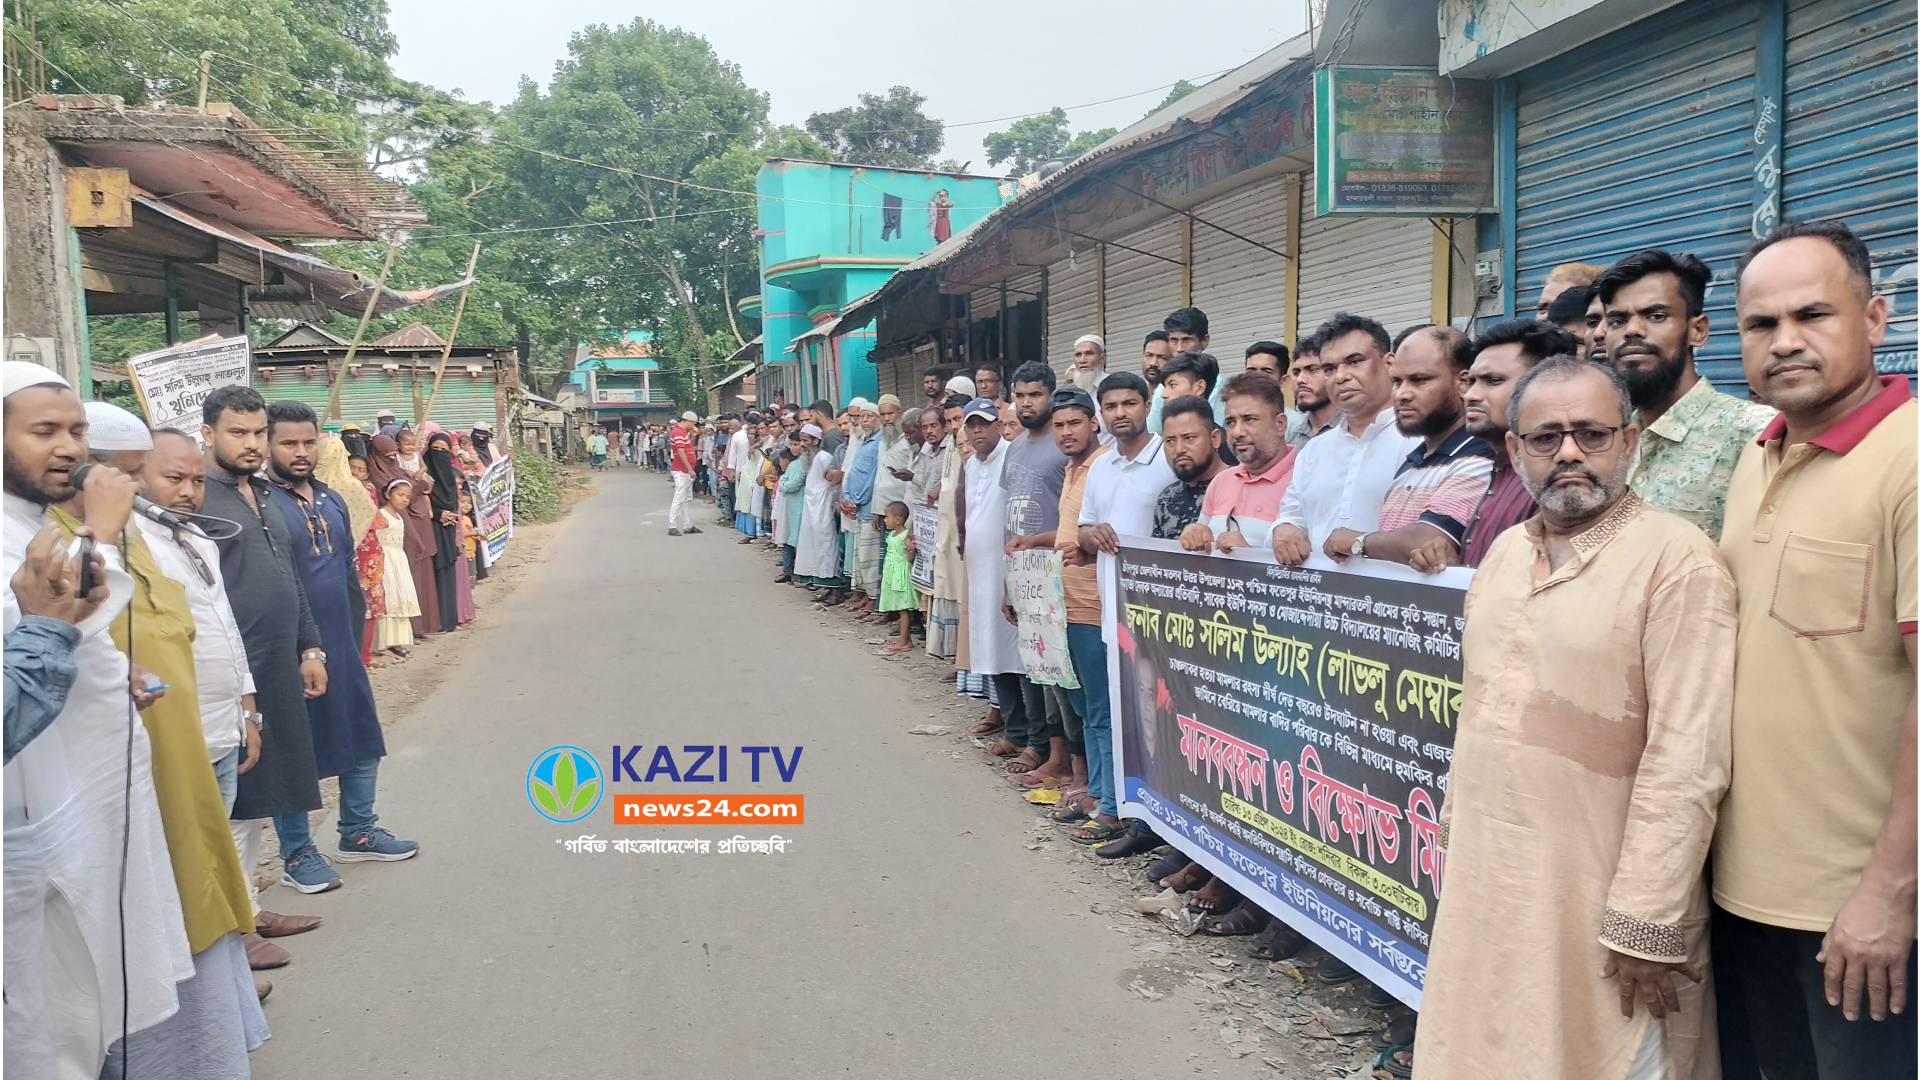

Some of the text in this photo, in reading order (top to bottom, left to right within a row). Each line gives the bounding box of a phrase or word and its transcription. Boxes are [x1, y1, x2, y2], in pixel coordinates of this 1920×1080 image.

[169, 388, 214, 415] খুনিদে
[1246, 578, 1268, 596] পশ্চিম
[1269, 584, 1298, 603] ফতেপুর
[1373, 602, 1398, 620] গ্রামের
[1401, 604, 1420, 627] কৃতি
[1269, 605, 1276, 618] ও
[1424, 632, 1460, 661] কমিটির
[1124, 603, 1161, 641] জনাব
[1165, 612, 1195, 649] মোঃ
[1199, 610, 1248, 663] সলিম
[1317, 640, 1390, 721] (লাভলু
[1217, 671, 1241, 691] মামলার
[1242, 678, 1261, 698] রহস্য
[1324, 702, 1358, 732] উদঘাটন
[1359, 719, 1371, 737] না
[1371, 723, 1396, 747] হওয়া
[1399, 734, 1420, 757] এবং
[1242, 702, 1267, 723] মামলার
[1268, 711, 1290, 731] বাদির
[1291, 719, 1318, 743] পরিবার
[1319, 731, 1333, 748] কে
[1334, 733, 1360, 763] বিভিন্ন
[1361, 748, 1392, 774] মাধ্যমে
[1396, 760, 1433, 788] হুমকির
[1177, 713, 1445, 899] মানববন্ধন ও বিক্ষোভ মি
[1165, 807, 1190, 837] ১১নং
[1193, 825, 1224, 857] পশ্চিম
[1226, 845, 1278, 891] ফতেপুর
[1281, 873, 1363, 946] ইউনিয়নের
[1348, 888, 1354, 901] ও
